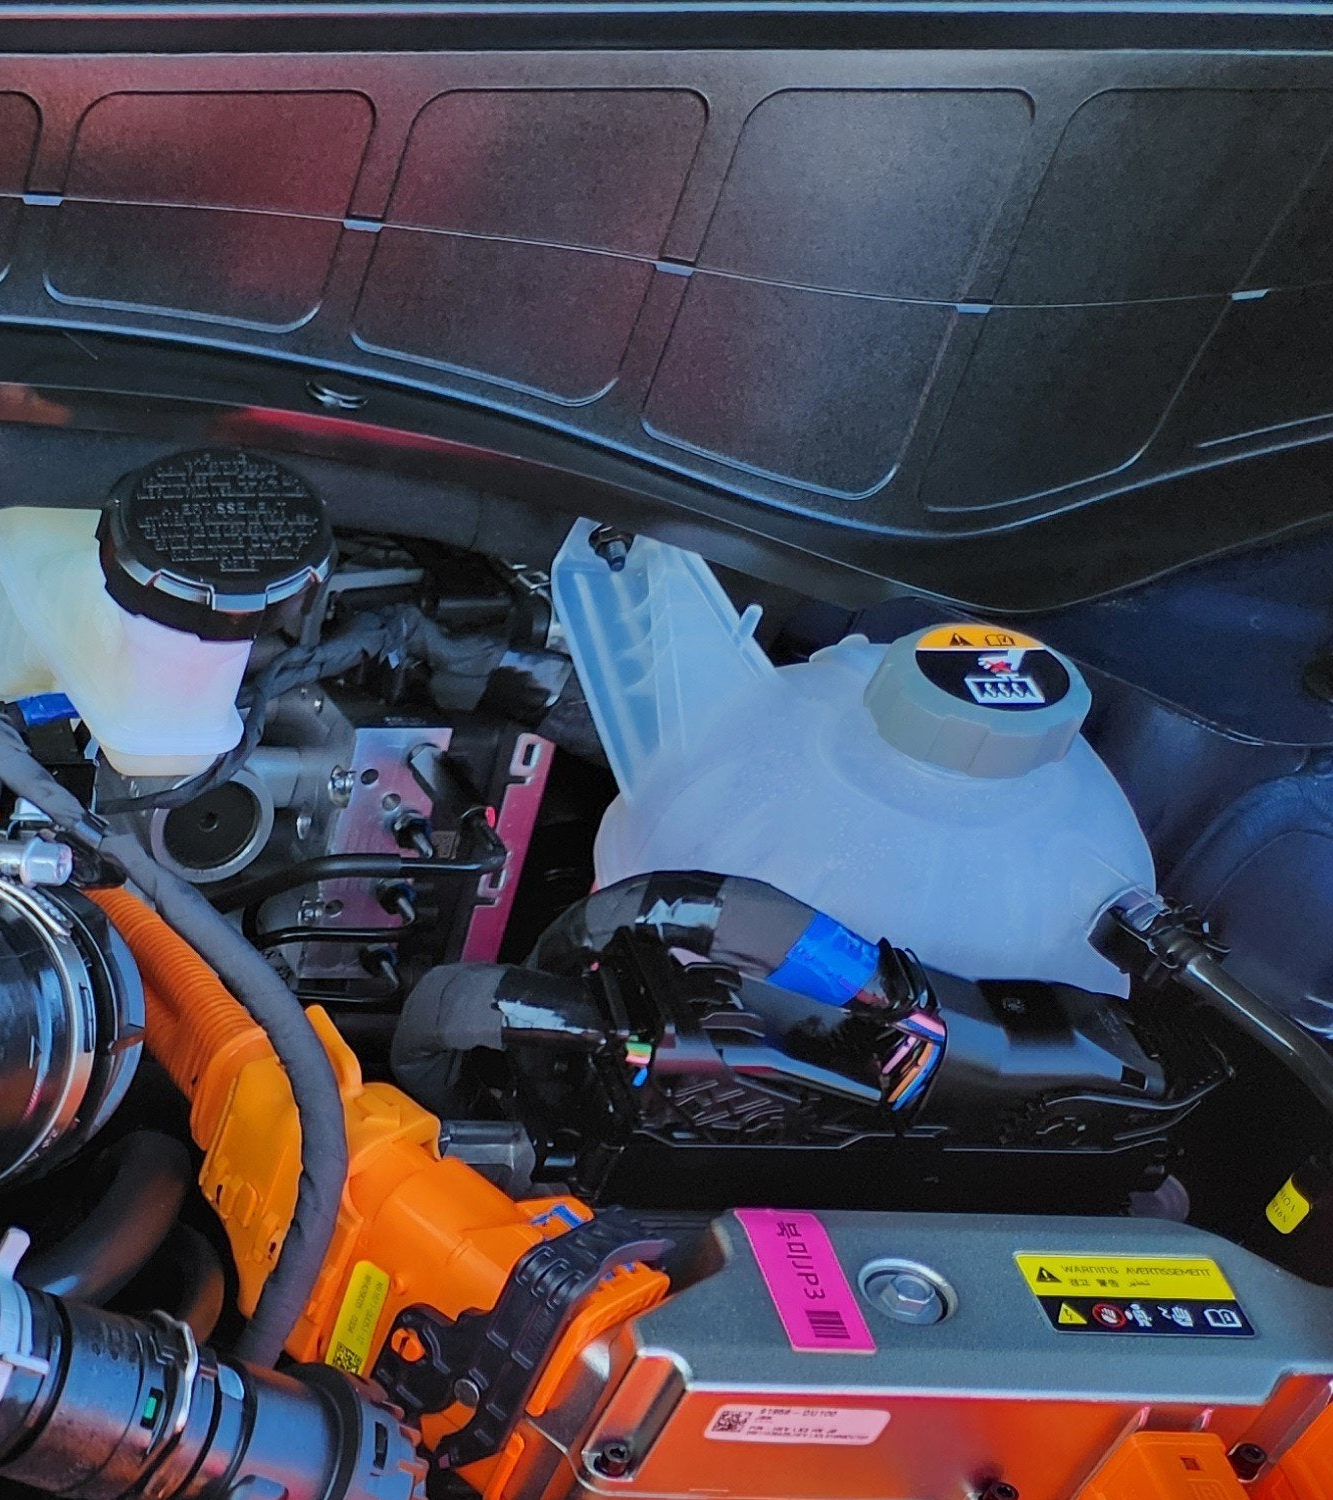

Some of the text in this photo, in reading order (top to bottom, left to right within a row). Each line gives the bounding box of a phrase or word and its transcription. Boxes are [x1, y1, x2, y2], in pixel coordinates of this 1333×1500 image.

[775, 1221, 827, 1301] 북미JP3
[1061, 1264, 1212, 1278] WARNING AVERTISSEMENT
